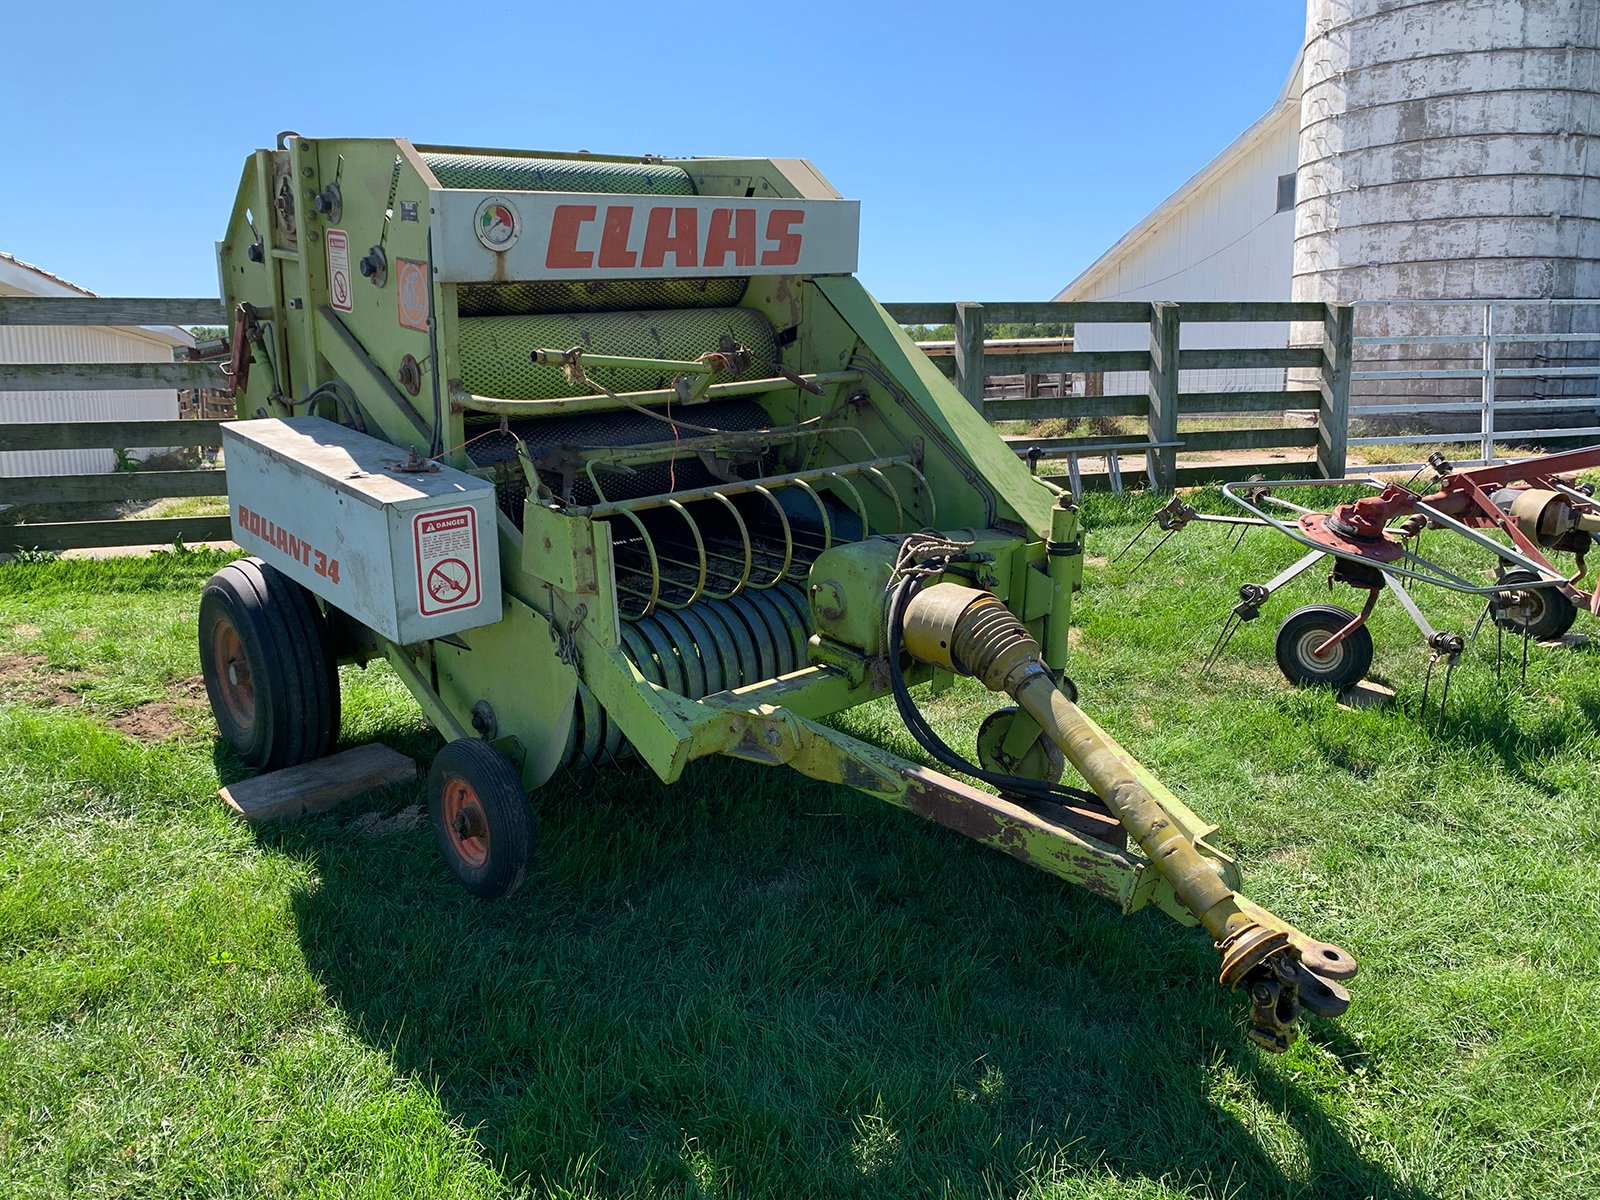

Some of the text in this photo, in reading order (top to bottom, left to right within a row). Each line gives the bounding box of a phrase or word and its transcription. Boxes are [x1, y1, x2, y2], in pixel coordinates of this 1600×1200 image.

[545, 205, 805, 269] CLAAS
[238, 505, 341, 585] ROLLANT 34
[436, 518, 465, 529] DANGER
